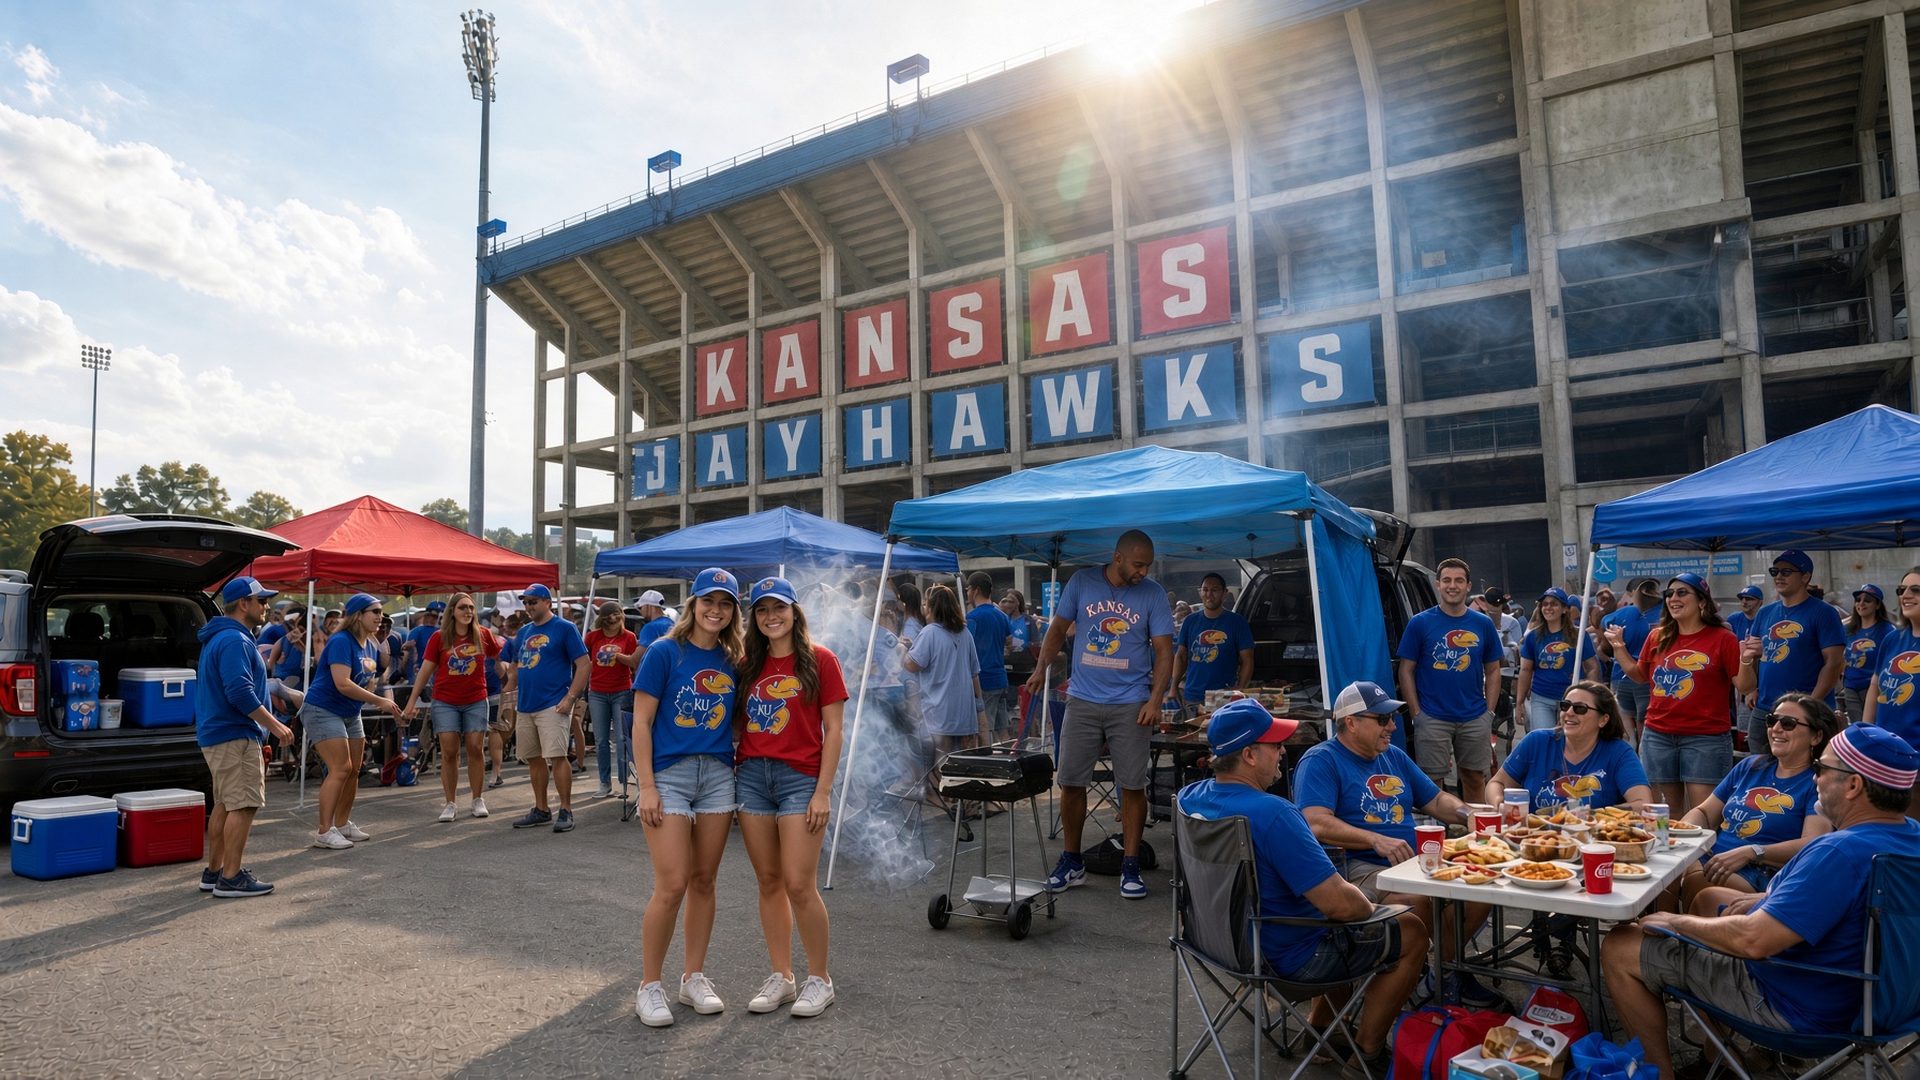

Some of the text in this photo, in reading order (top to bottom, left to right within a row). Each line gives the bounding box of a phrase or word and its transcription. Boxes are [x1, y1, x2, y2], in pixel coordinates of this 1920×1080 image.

[706, 242, 1207, 406] KANSAS
[646, 333, 1344, 490] JAYHAWKS
[1086, 600, 1140, 625] KANSAS
[694, 698, 709, 711] KU
[757, 704, 772, 716] KU
[1731, 808, 1748, 821] KU
